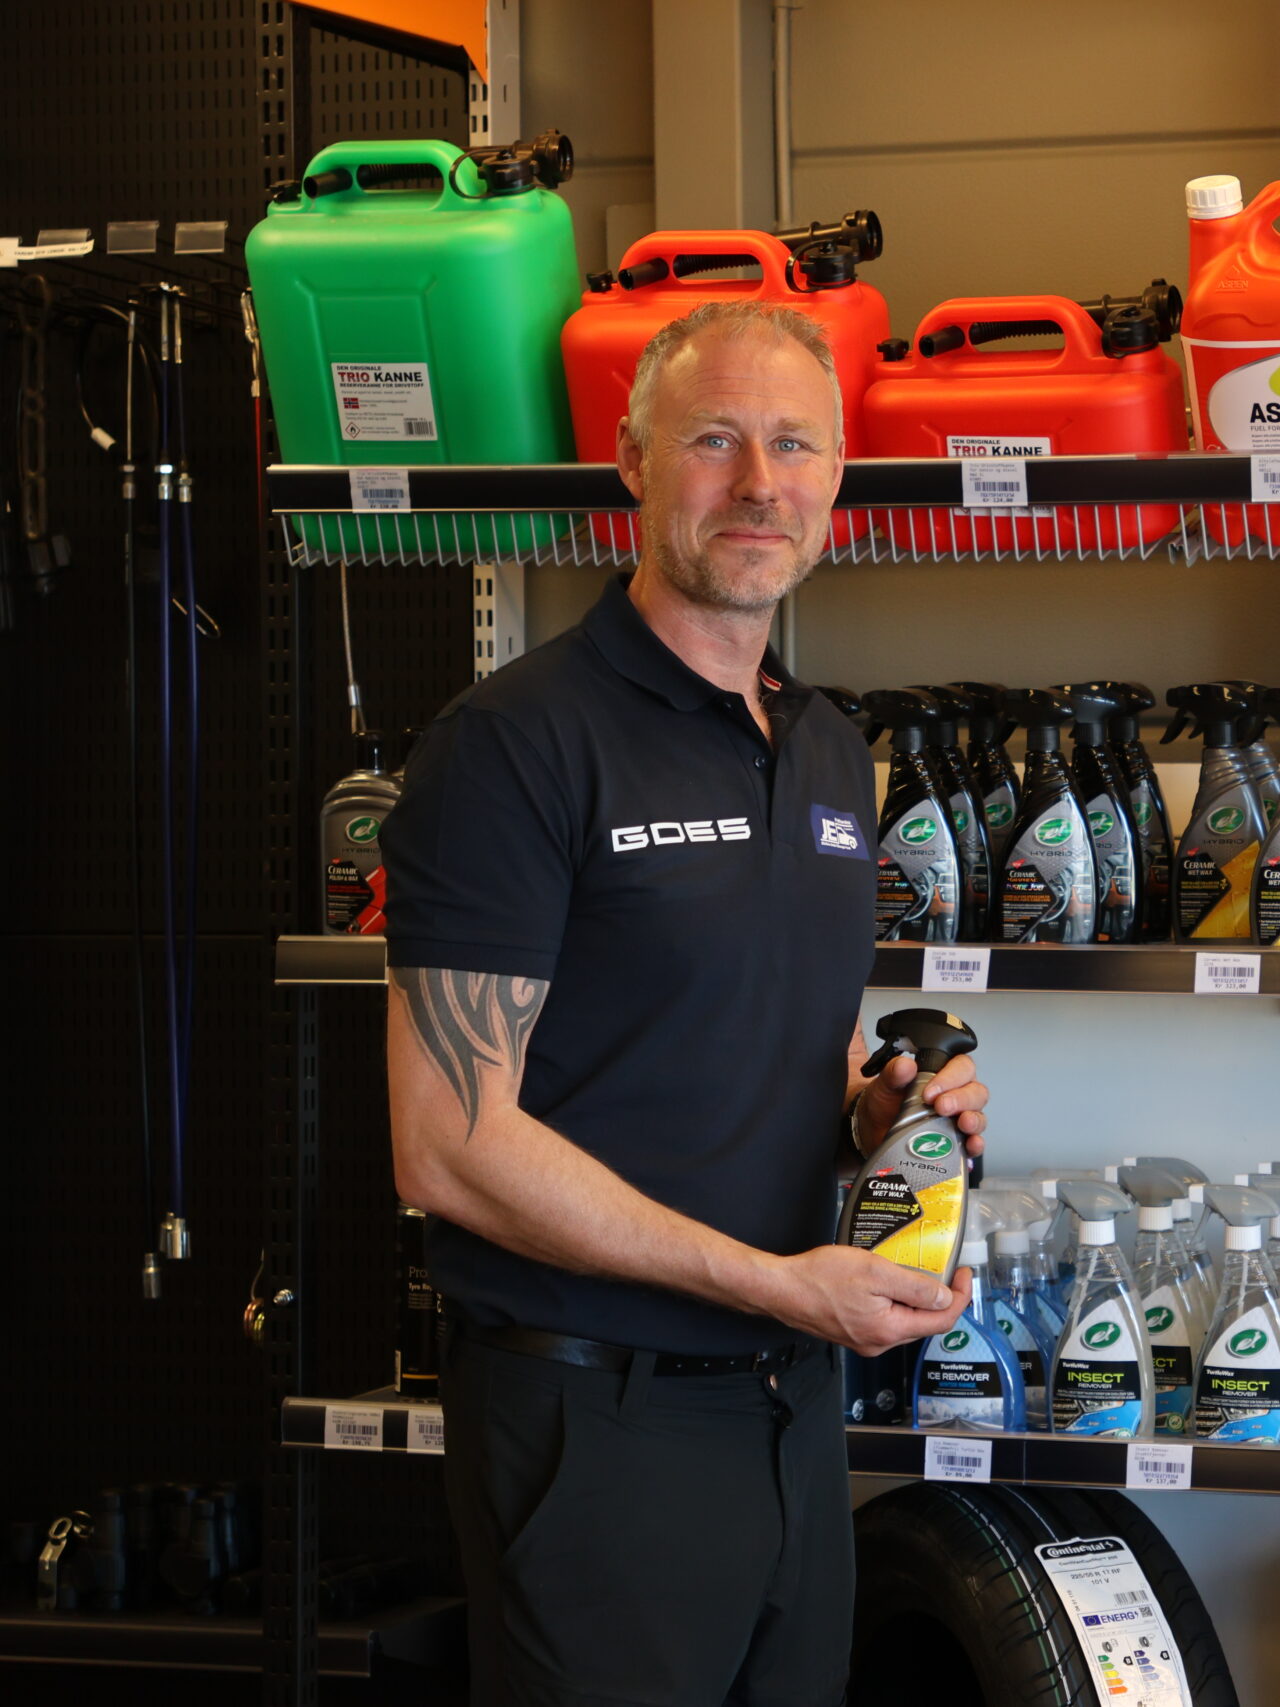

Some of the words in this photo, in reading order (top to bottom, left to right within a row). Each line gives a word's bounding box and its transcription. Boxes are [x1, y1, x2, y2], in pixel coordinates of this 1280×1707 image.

[337, 372, 370, 383] TRIO
[373, 371, 423, 382] KANNE
[1250, 424, 1266, 432] FUEL
[1267, 424, 1280, 432] FOR
[952, 445, 987, 457] TRIO
[991, 446, 1043, 457] KANNE
[611, 817, 752, 853] GOES
[328, 866, 359, 875] CERAMIC
[1183, 860, 1216, 869] CERAMIC
[1008, 870, 1037, 878] CERAMIC
[899, 1160, 948, 1175] HYBRID
[868, 1180, 911, 1192] CERAMIC
[927, 1372, 940, 1380] ICE
[942, 1372, 990, 1381] REMOVER
[1067, 1372, 1124, 1384] INSECT
[1211, 1380, 1270, 1391] INSECT
[1046, 1542, 1106, 1558] Continental
[1101, 1611, 1136, 1624] ENERG
